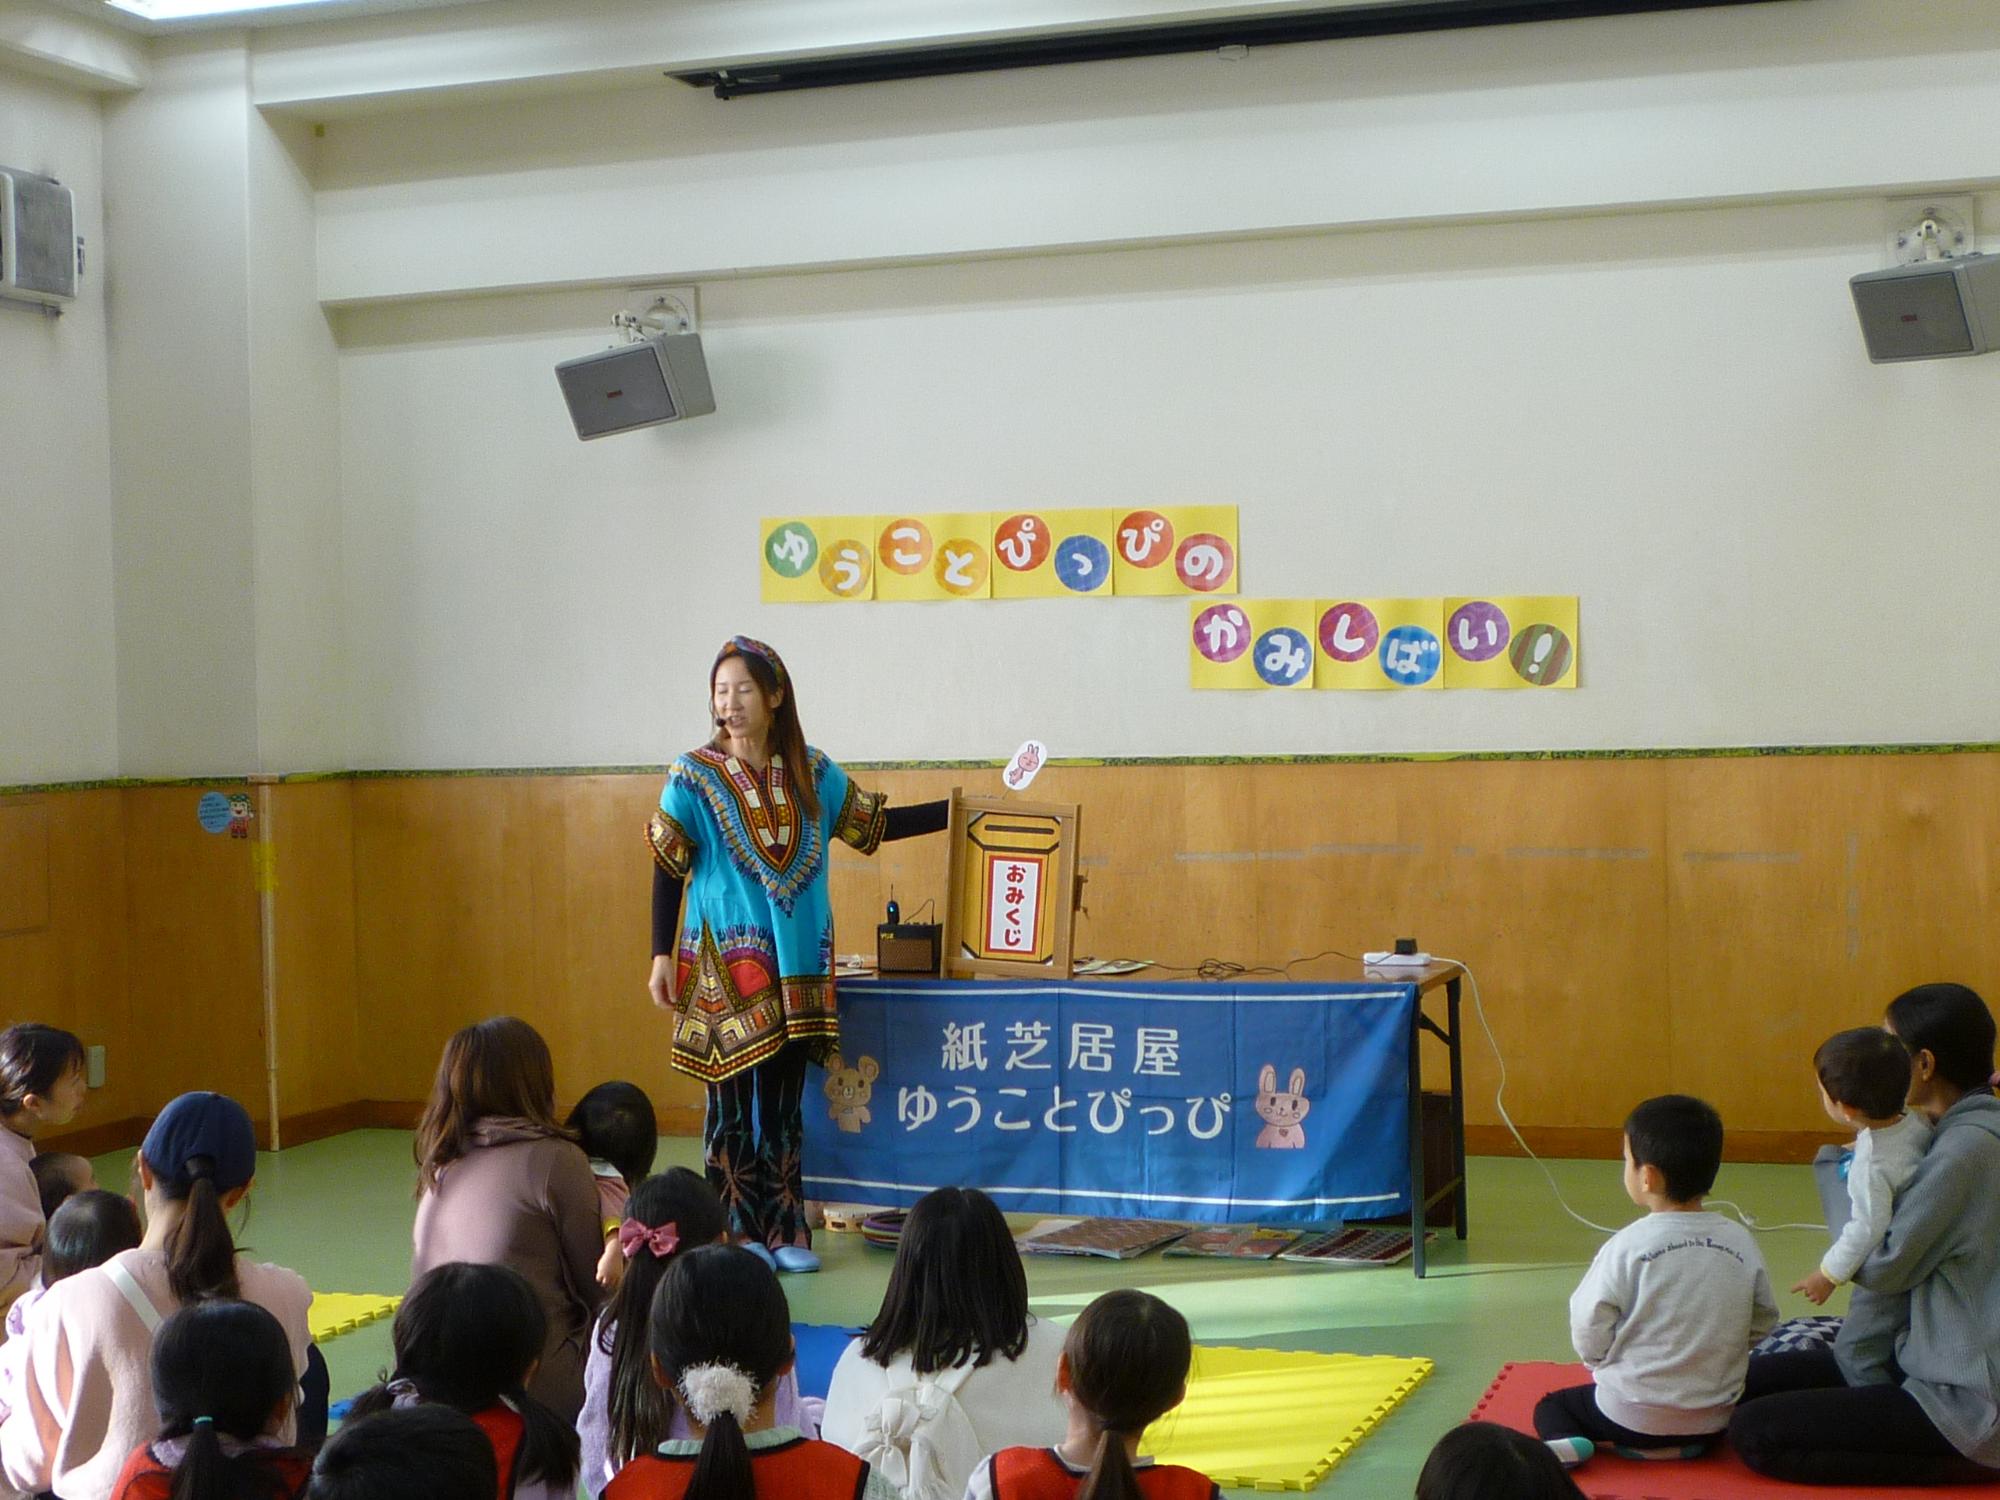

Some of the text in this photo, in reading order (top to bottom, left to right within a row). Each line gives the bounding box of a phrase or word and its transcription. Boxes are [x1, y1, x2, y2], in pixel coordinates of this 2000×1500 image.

[773, 518, 1224, 591] ゆうことぴっぴの
[1004, 863, 1027, 947] おみくじ
[940, 1020, 1182, 1077] 紙芝居屋
[897, 1085, 1232, 1140] ゆうことぴっぴ
